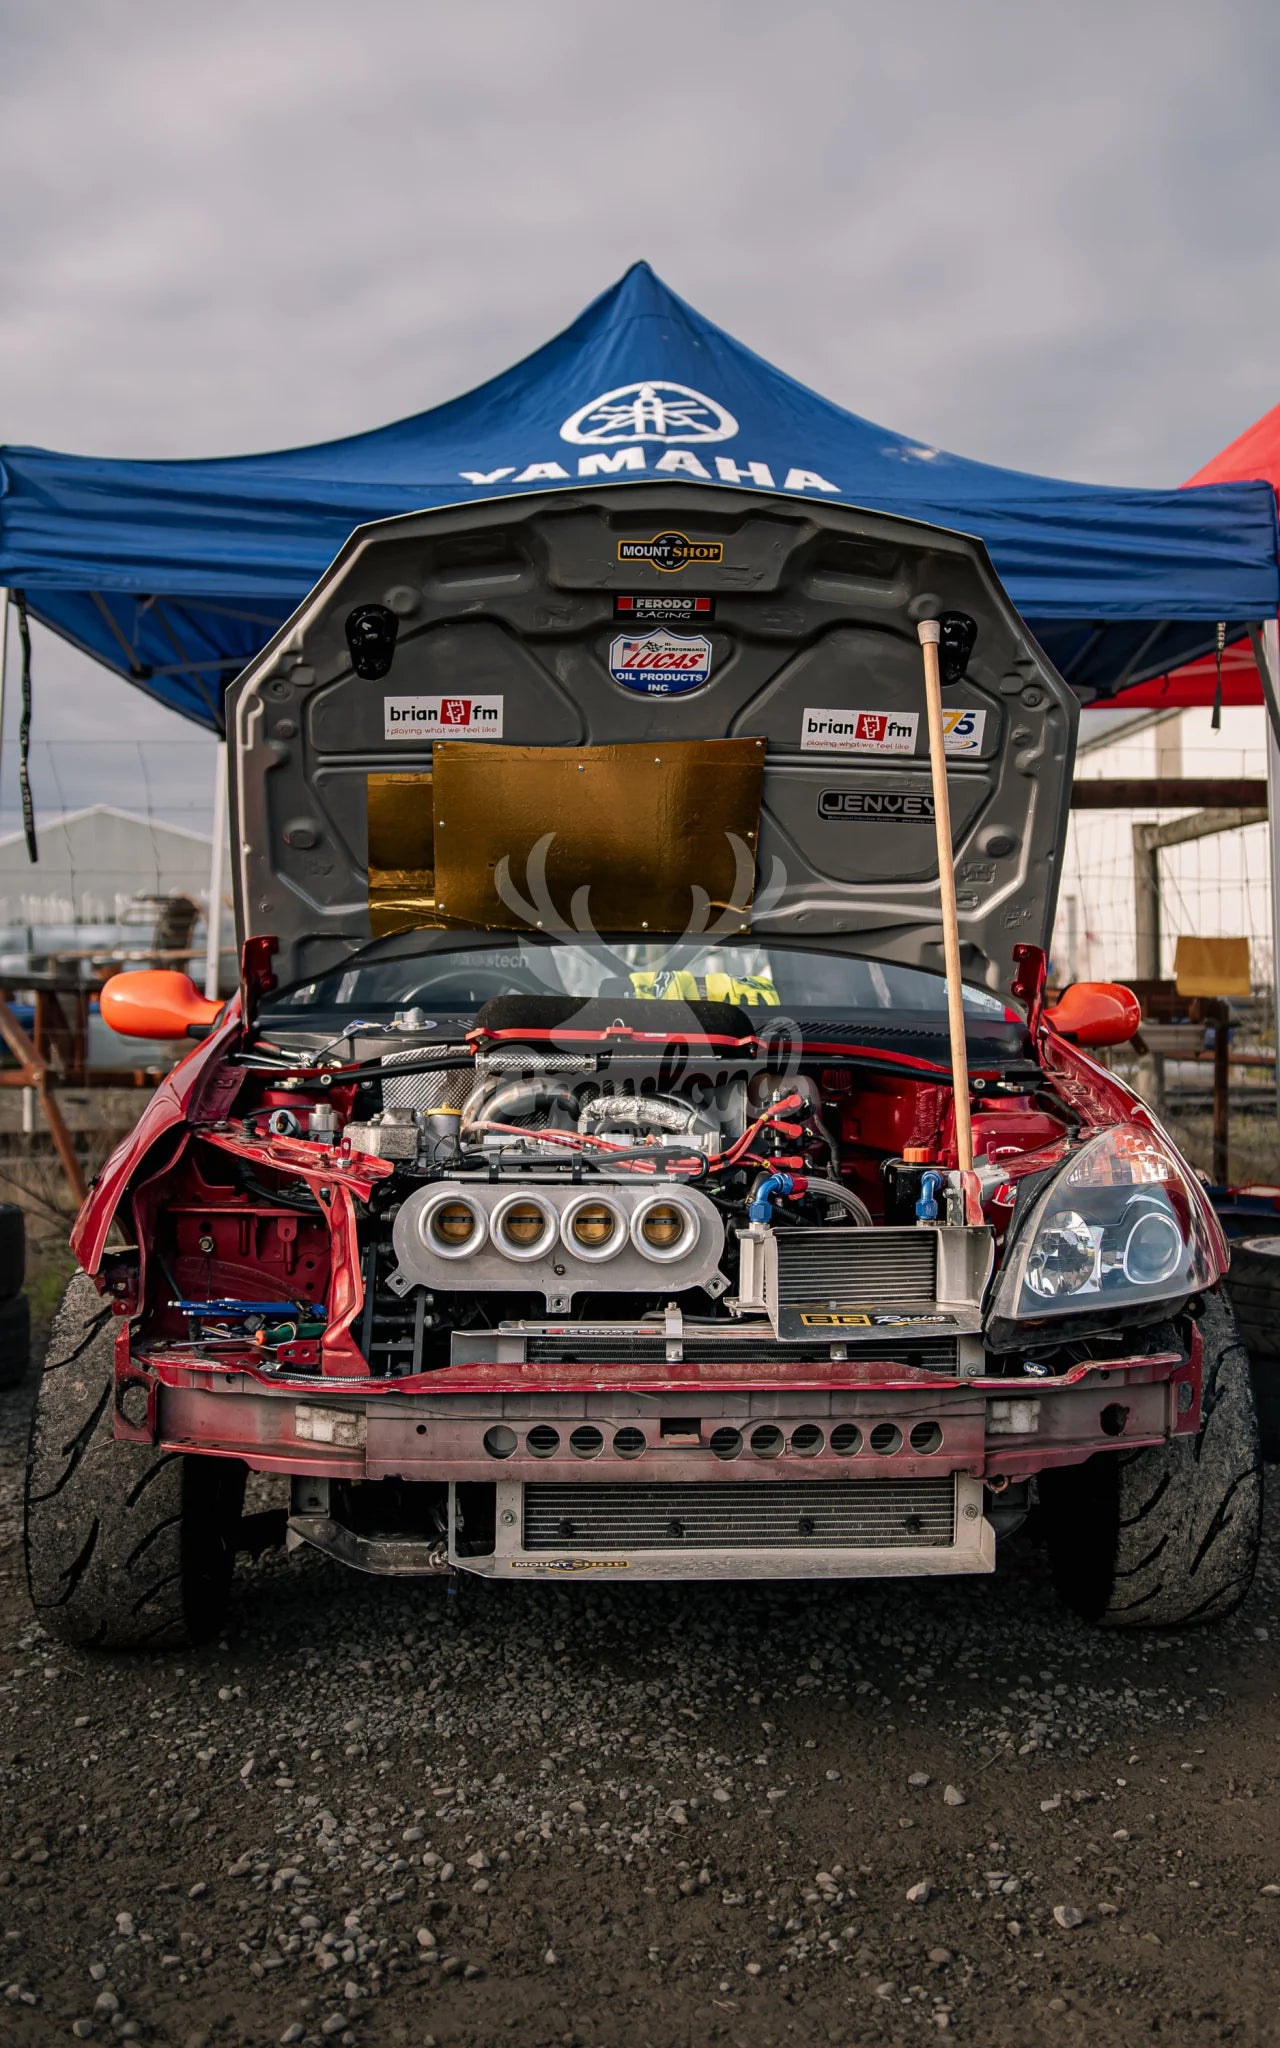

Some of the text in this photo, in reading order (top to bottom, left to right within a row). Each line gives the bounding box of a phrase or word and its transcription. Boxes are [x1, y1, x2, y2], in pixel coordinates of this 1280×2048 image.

[459, 446, 841, 492] YAMAHA
[622, 545, 719, 558] MOUNT SHOP
[636, 598, 693, 609] FERODO
[636, 611, 692, 619] RACING
[621, 652, 704, 669] LUCAS
[615, 672, 703, 682] OIL PRODUCTS
[390, 705, 498, 721] brian fm
[807, 718, 912, 737] brian fm
[942, 712, 976, 735] 75
[390, 727, 422, 736] playing
[424, 726, 446, 734] what
[806, 740, 837, 748] playing
[838, 740, 860, 748] what
[876, 742, 893, 750] feel
[894, 742, 910, 751] like
[874, 1315, 946, 1325] Racing
